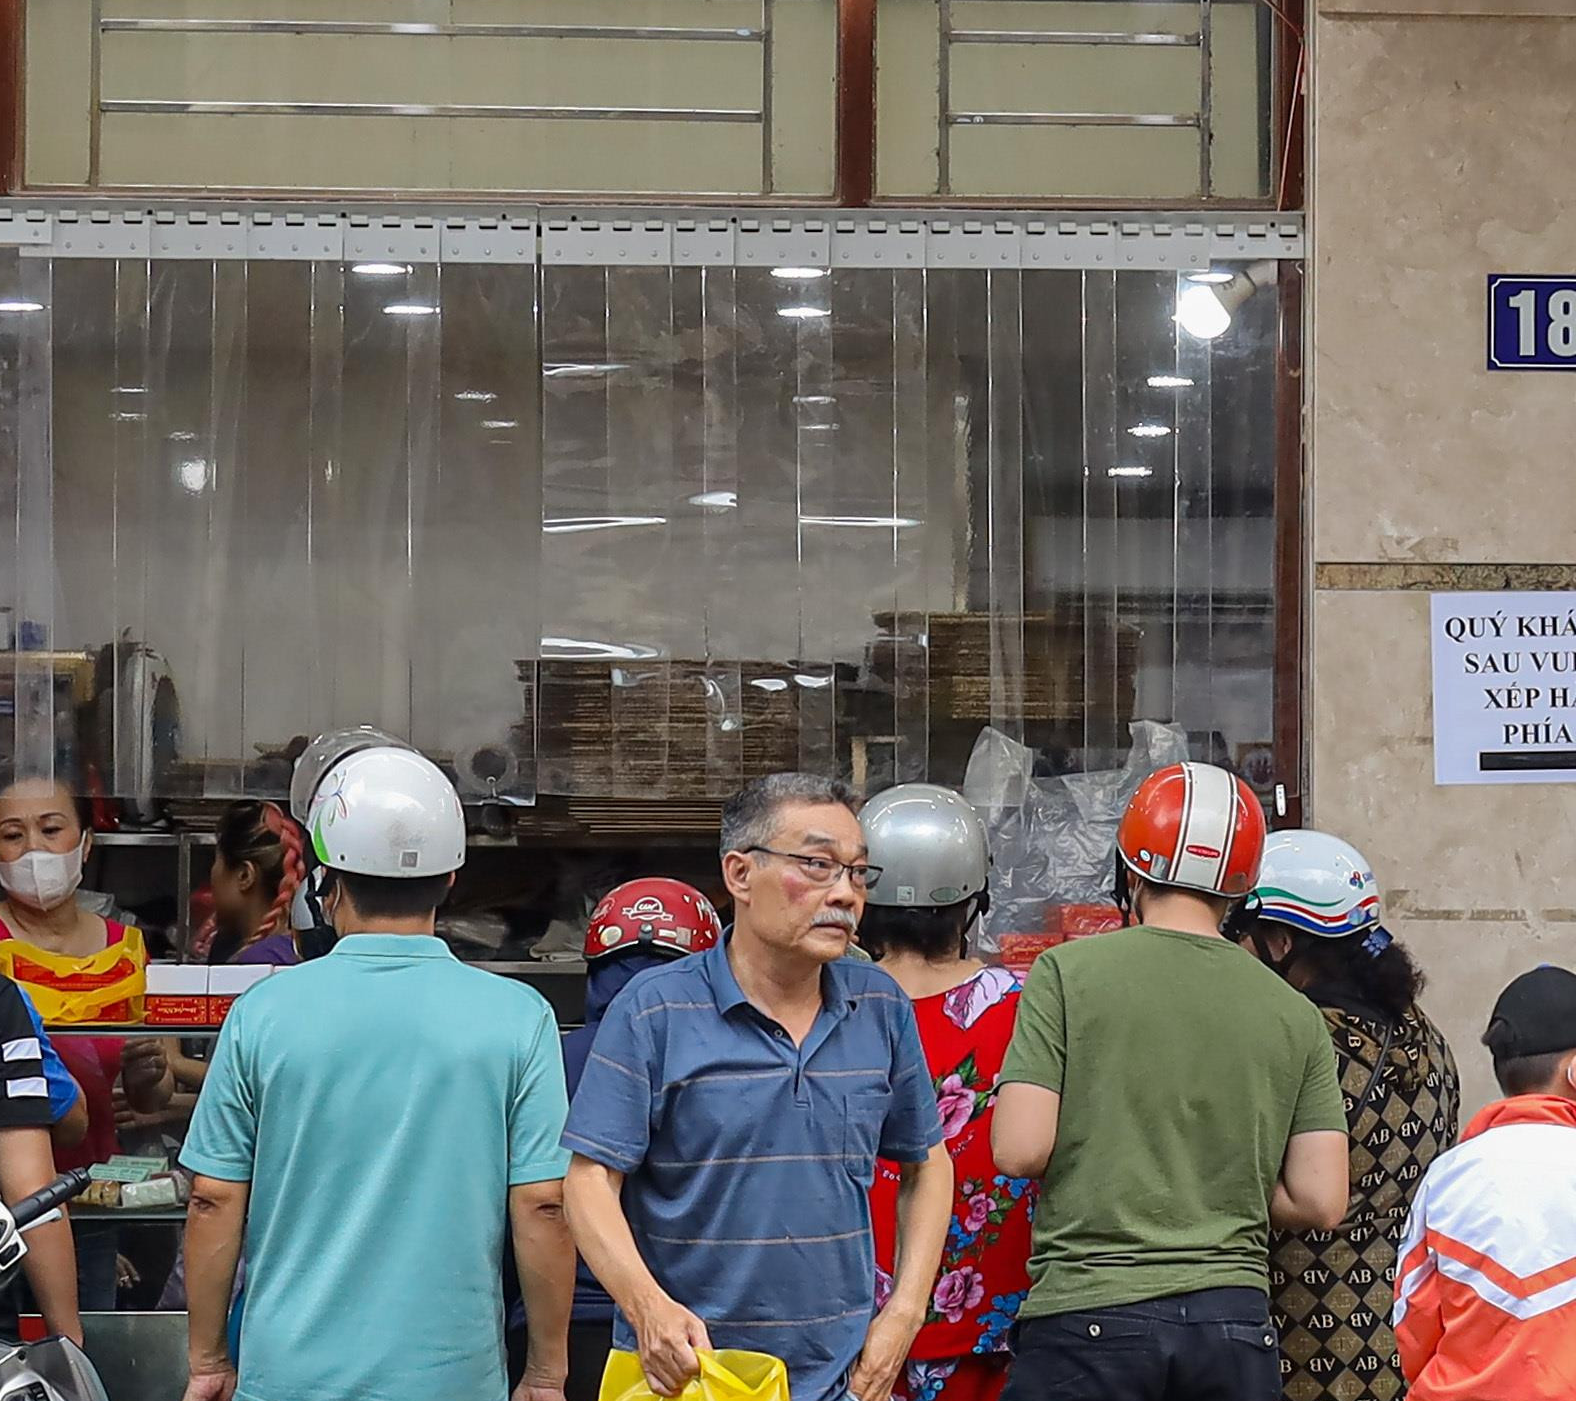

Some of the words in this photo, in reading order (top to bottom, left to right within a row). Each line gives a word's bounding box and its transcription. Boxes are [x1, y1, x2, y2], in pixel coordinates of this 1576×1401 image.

[1444, 610, 1508, 644] QUÝ
[1464, 650, 1521, 675] SAU
[1484, 680, 1540, 710] XẾP
[1502, 718, 1574, 746] PHÍA
[1367, 1127, 1392, 1149] AB
[1307, 1314, 1335, 1330] AB
